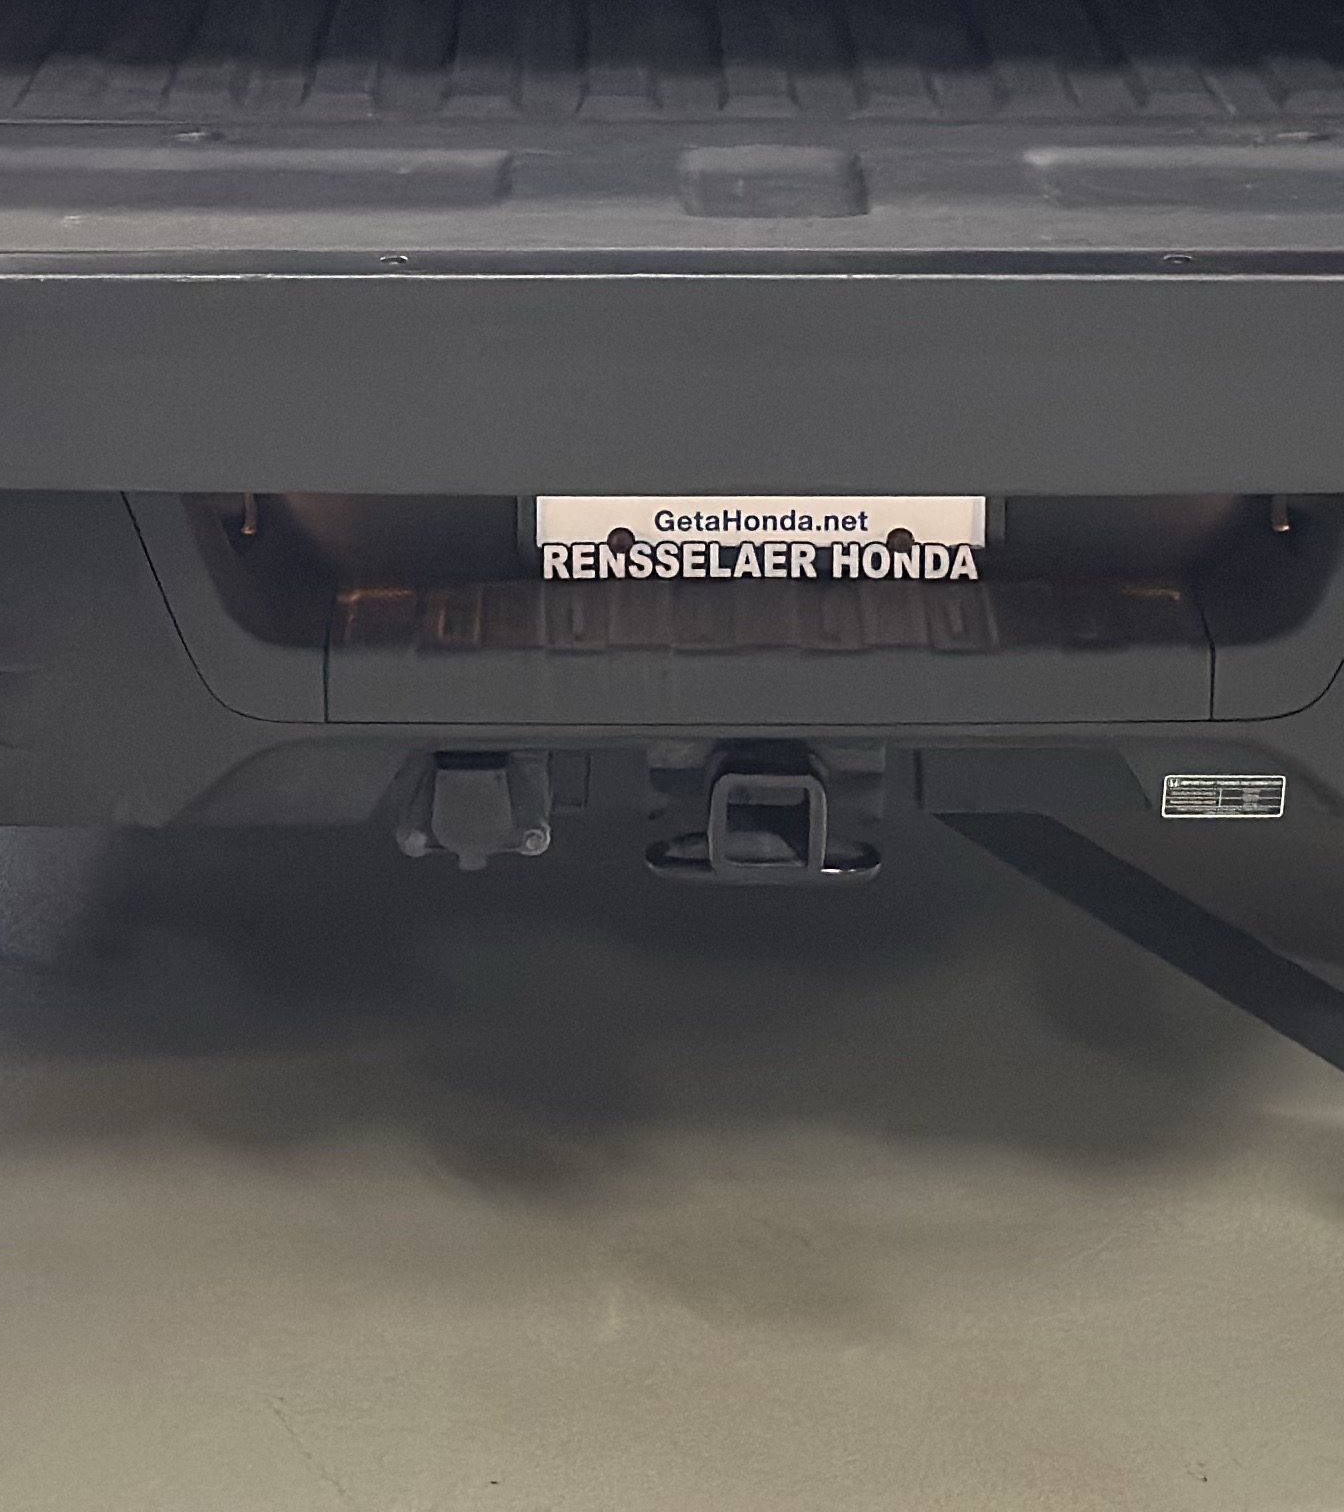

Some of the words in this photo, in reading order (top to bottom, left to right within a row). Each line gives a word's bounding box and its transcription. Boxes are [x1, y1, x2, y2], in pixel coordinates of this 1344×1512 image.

[655, 509, 869, 532] GetaHonda.net
[542, 541, 818, 580] RENSSELAER
[832, 542, 980, 580] HONDA
